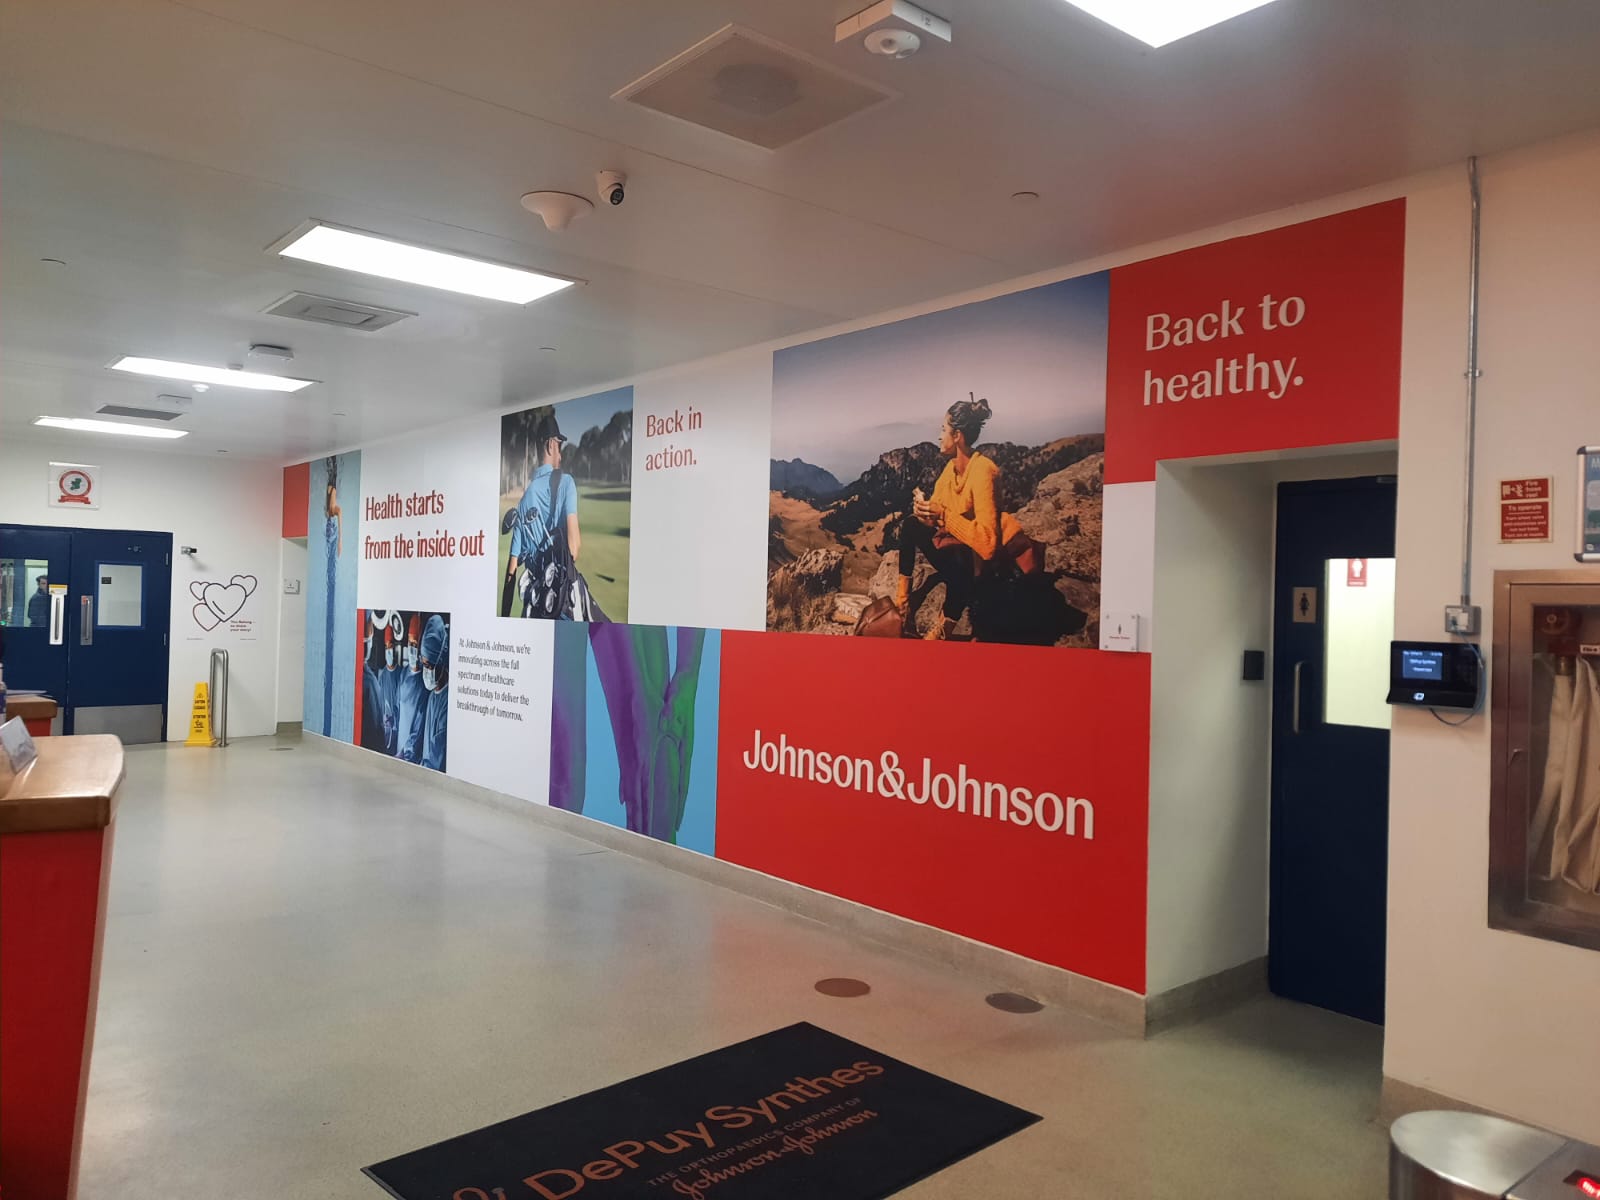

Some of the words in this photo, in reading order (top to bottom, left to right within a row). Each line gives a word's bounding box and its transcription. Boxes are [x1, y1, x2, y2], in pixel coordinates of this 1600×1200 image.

[1146, 300, 1245, 351] Back
[1258, 294, 1305, 331] to
[1143, 352, 1304, 406] healthy.
[646, 409, 683, 438] Back
[689, 406, 702, 430] in
[645, 444, 697, 471] action.
[366, 492, 403, 521] Health
[406, 489, 444, 517] starts
[365, 535, 391, 560] from
[394, 533, 414, 558] the
[417, 529, 456, 558] inside
[459, 529, 485, 557] out
[458, 653, 482, 668] innovating
[483, 658, 500, 668] across
[501, 658, 510, 669] the
[511, 659, 520, 670] full
[465, 639, 486, 650] Johnson
[486, 640, 491, 651] &
[516, 644, 531, 655] we're
[458, 670, 481, 680] spectrum
[481, 672, 487, 682] of
[487, 672, 515, 686] healthcare
[457, 684, 479, 696] solutions
[480, 688, 493, 701] today
[494, 691, 500, 701] to
[501, 691, 519, 703] deliver
[520, 694, 530, 706] the
[457, 699, 489, 717] breakthrough
[490, 705, 496, 716] of
[496, 708, 523, 721] tomorrow.
[743, 729, 1094, 840] Johnson&Johnson
[522, 1121, 716, 1200] DePuy
[705, 1061, 884, 1128] Synthes
[648, 1170, 679, 1187] THE
[681, 1129, 785, 1174] ORTHOPAEDICS
[784, 1103, 843, 1132] COMPANY
[845, 1096, 862, 1107] OF
